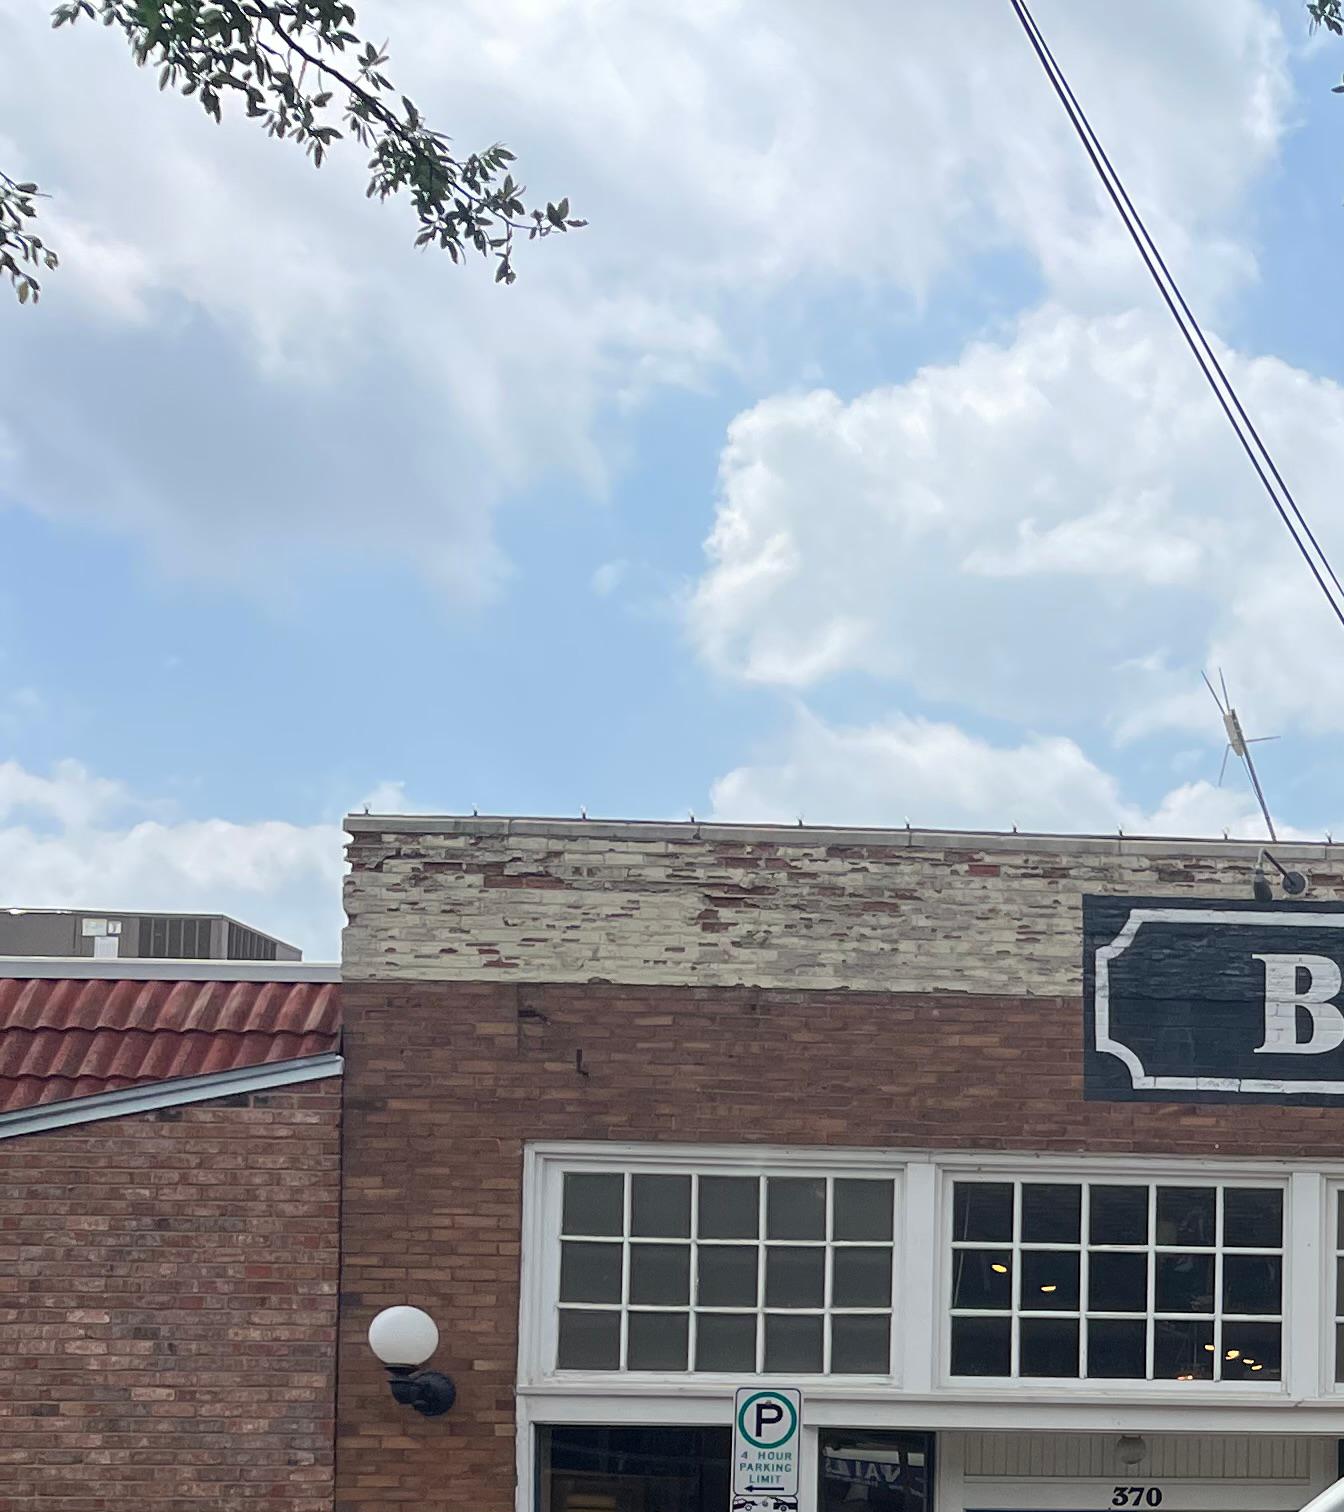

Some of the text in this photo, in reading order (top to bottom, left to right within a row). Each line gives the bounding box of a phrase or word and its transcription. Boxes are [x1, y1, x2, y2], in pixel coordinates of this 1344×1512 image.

[756, 1403, 783, 1437] P
[758, 1451, 792, 1461] HOUR
[740, 1463, 792, 1472] PARKING
[749, 1475, 781, 1484] LIMIT
[1111, 1486, 1163, 1507] 370
